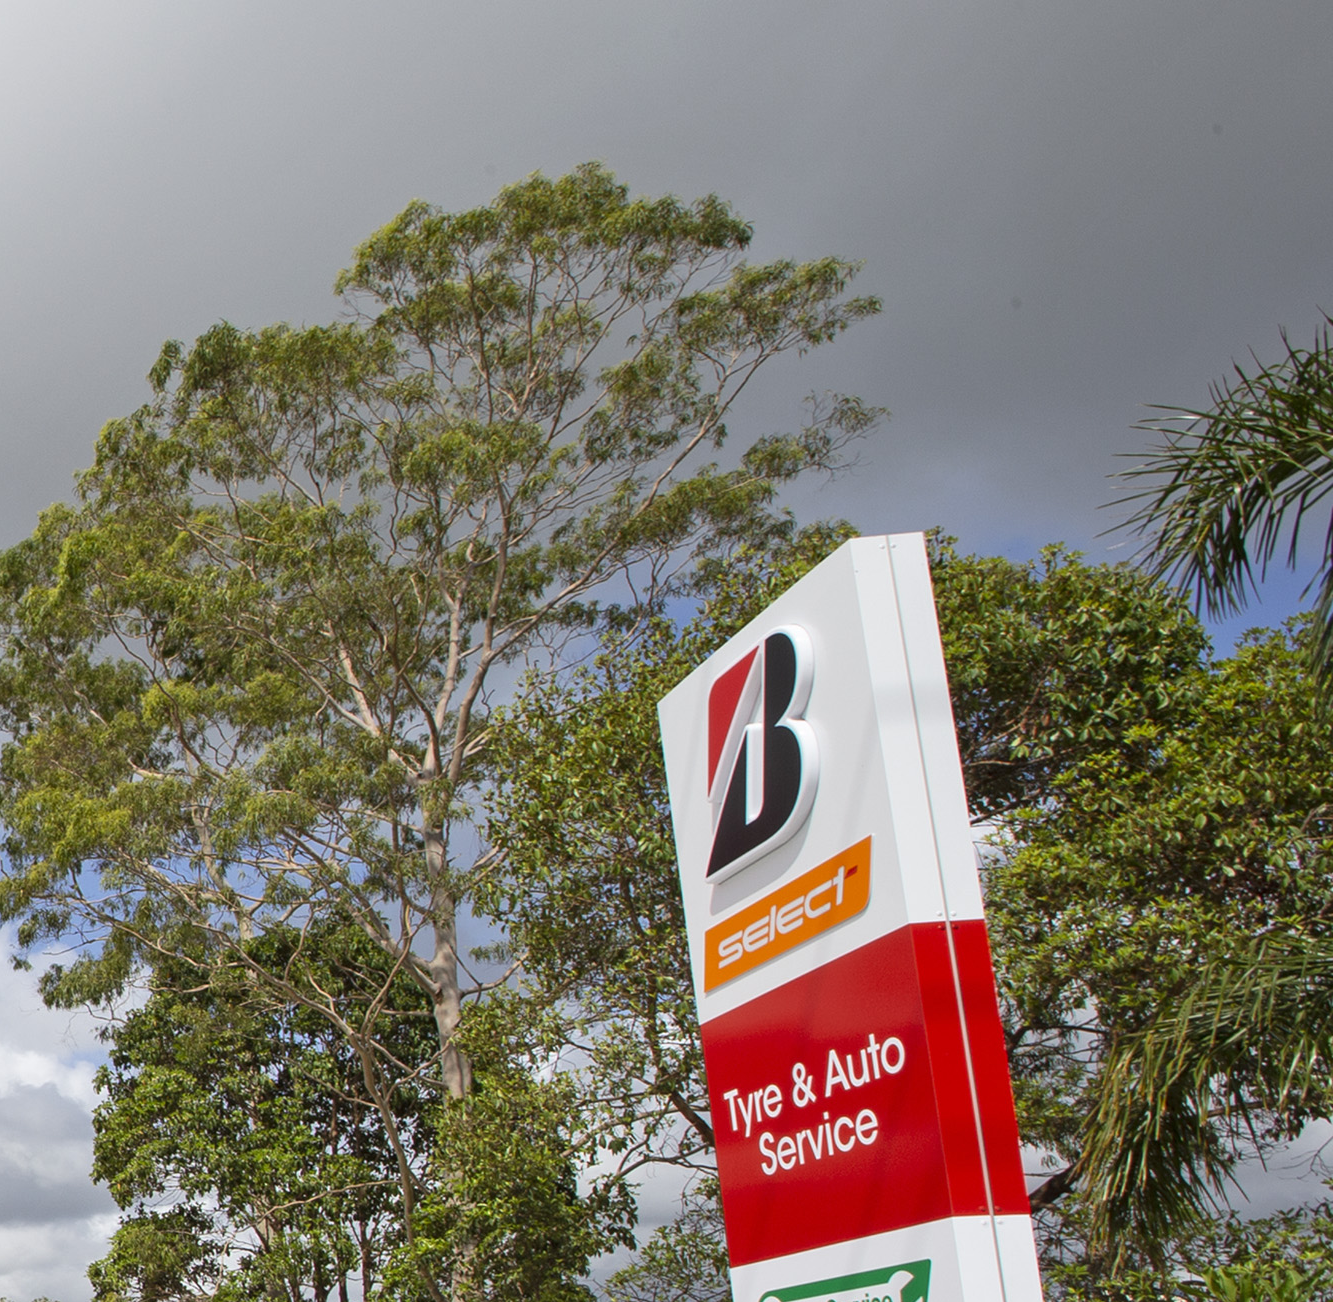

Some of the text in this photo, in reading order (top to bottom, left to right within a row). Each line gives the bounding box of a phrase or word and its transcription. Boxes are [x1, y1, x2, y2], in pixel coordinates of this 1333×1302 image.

[723, 1033, 906, 1138] Tyre & Auto
[759, 1108, 879, 1176] Service
